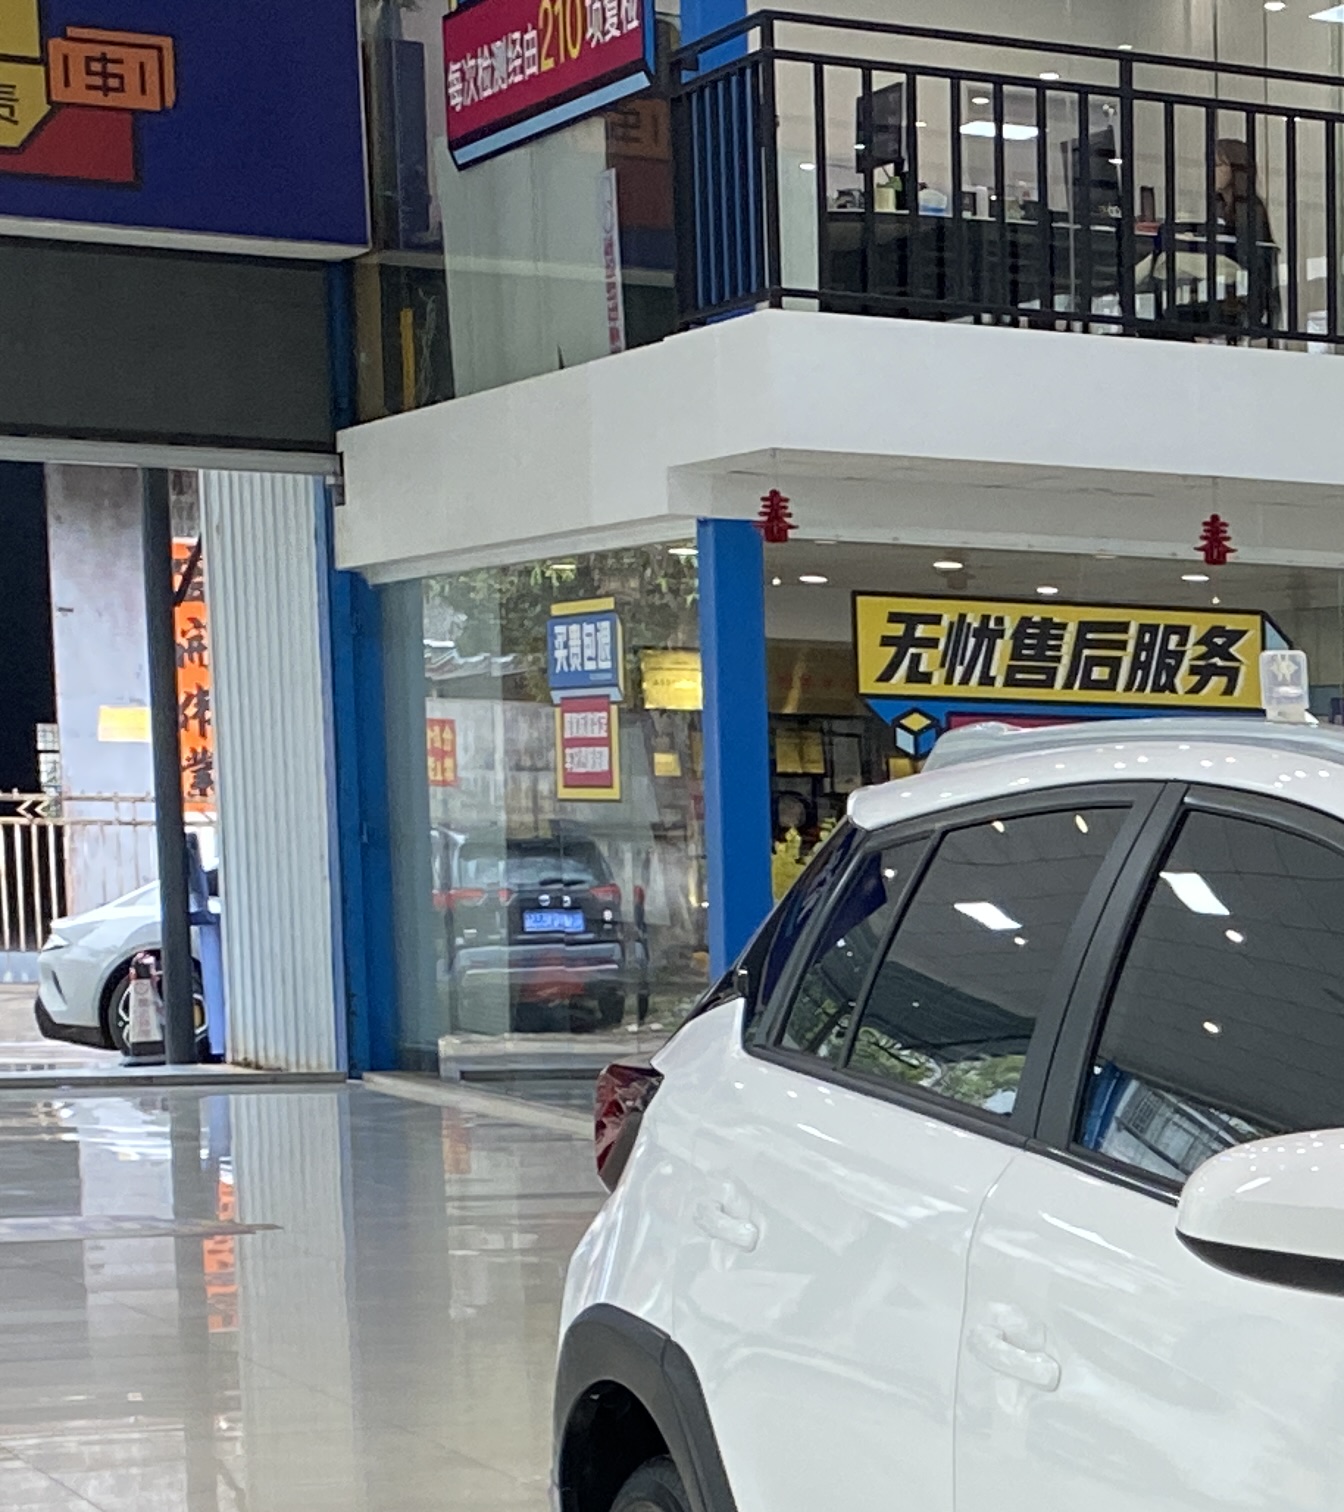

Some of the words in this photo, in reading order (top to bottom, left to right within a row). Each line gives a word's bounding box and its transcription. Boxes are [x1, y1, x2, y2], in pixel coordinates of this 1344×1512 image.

[554, 620, 612, 674] 买贵包退
[874, 610, 1254, 697] 无忧售后服务
